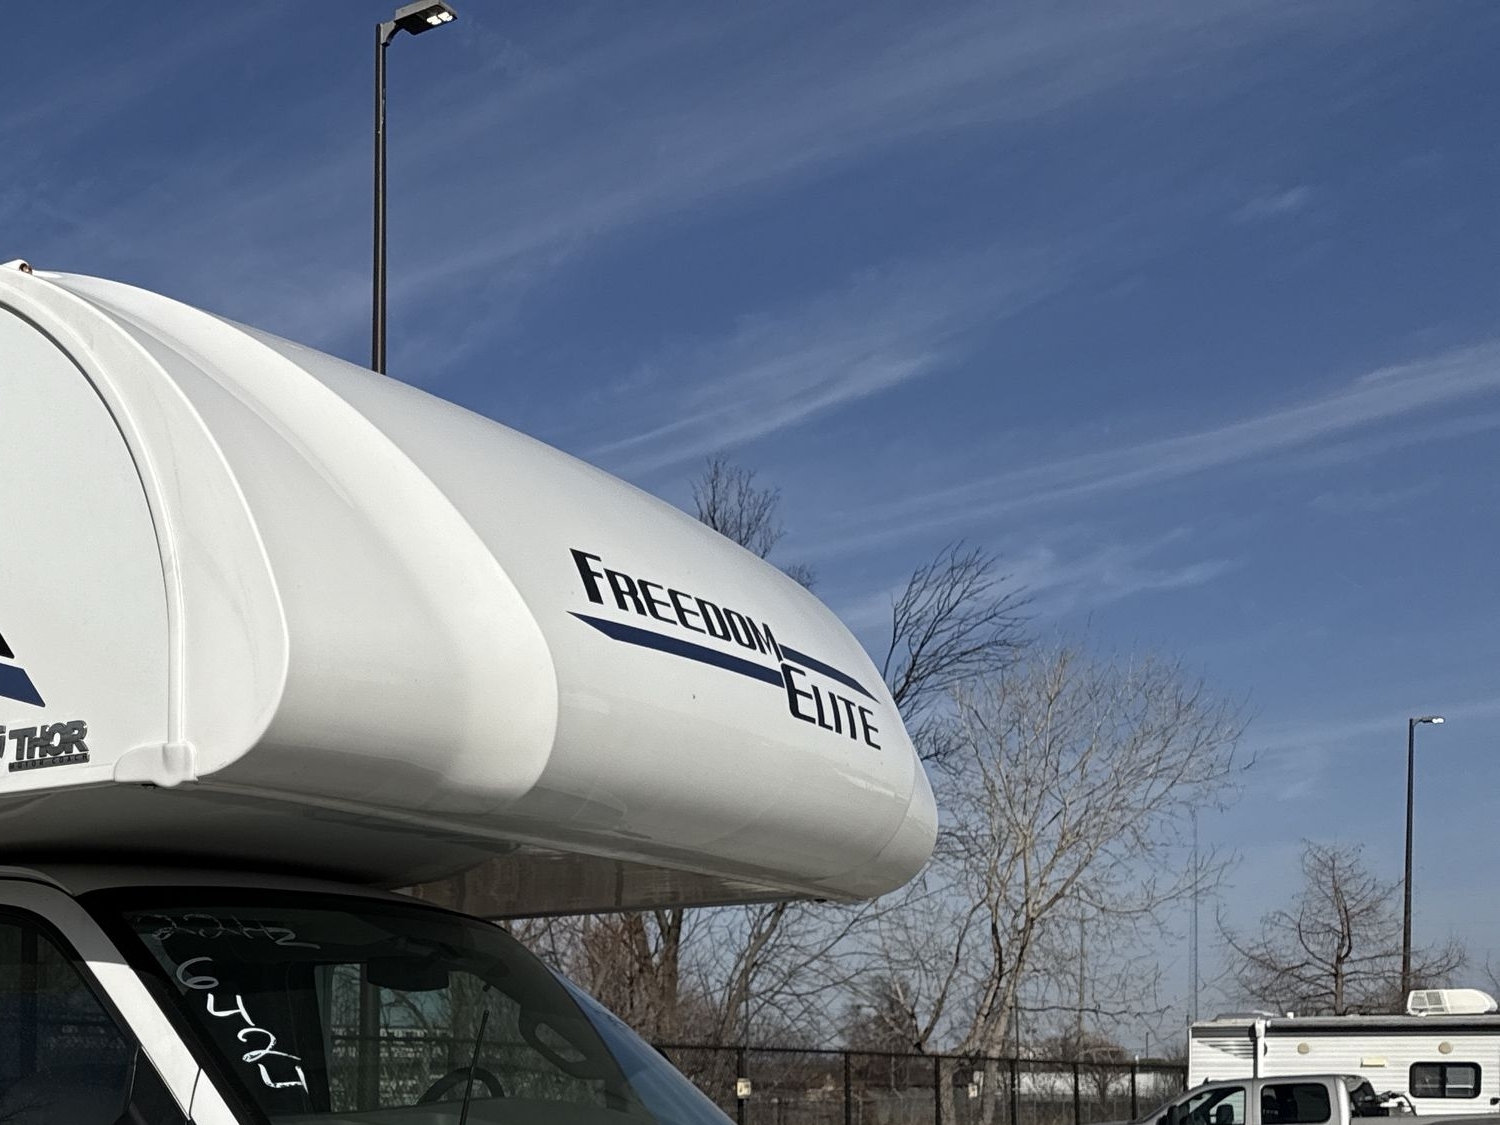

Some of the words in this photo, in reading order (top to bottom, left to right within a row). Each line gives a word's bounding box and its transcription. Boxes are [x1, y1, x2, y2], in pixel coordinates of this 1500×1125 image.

[569, 547, 784, 663] FREEDOM
[780, 662, 882, 751] ELITE
[9, 720, 89, 761] THOR
[9, 761, 44, 770] MOTOR
[52, 754, 88, 764] COACH
